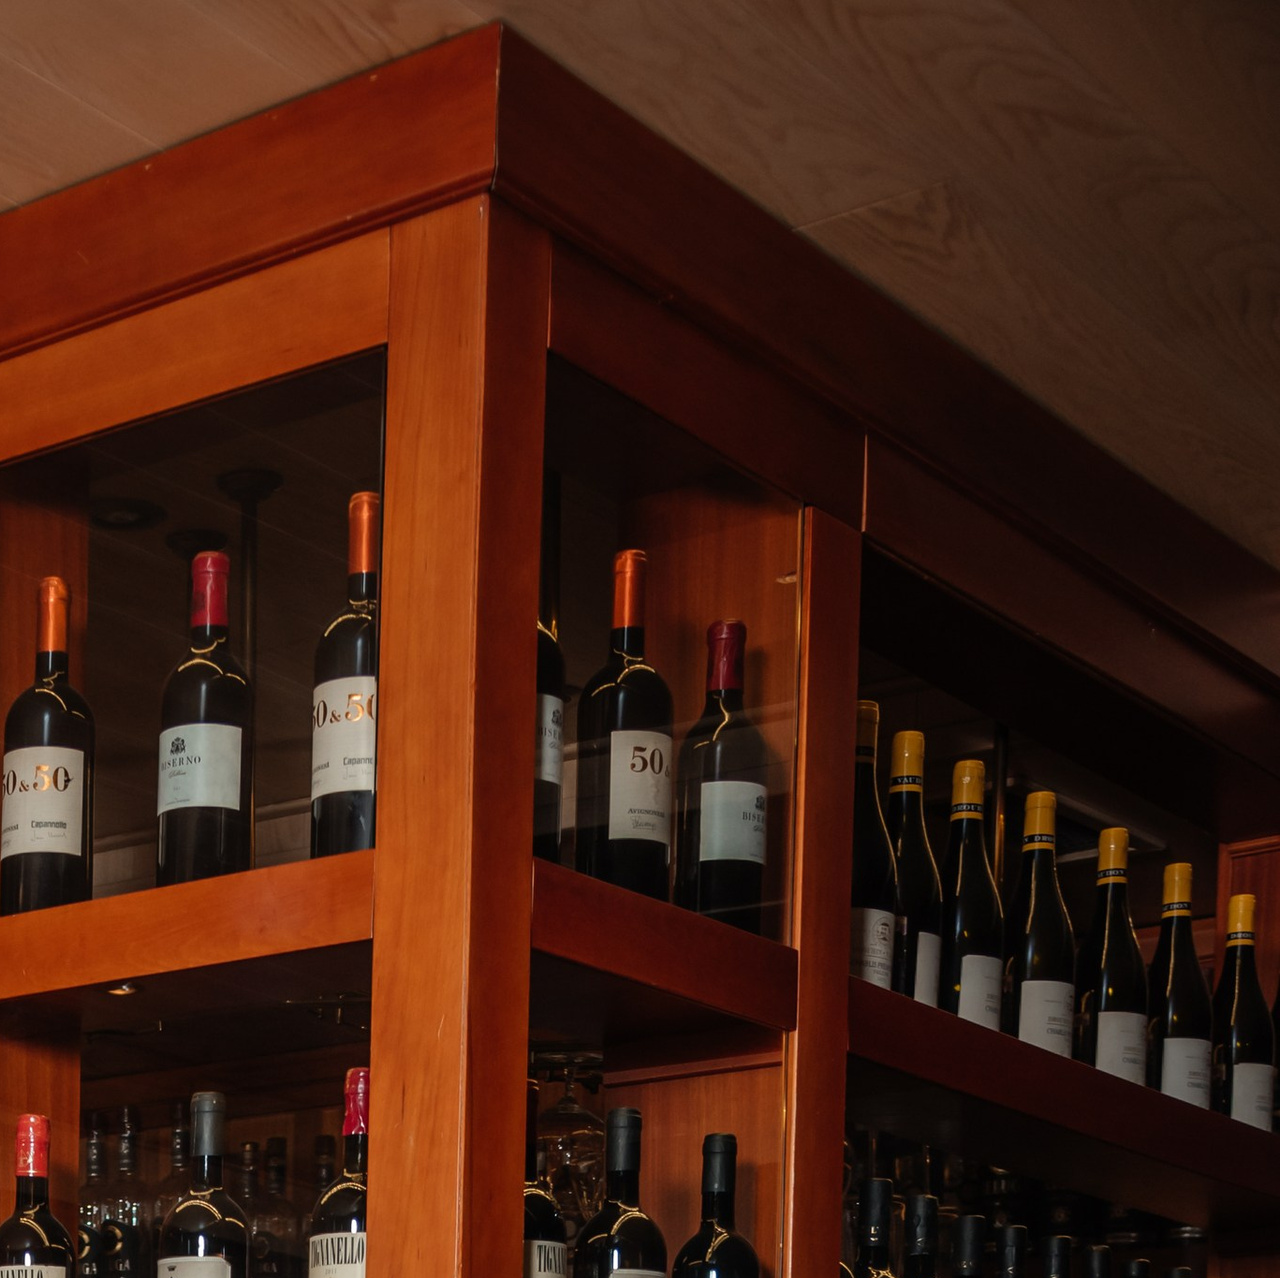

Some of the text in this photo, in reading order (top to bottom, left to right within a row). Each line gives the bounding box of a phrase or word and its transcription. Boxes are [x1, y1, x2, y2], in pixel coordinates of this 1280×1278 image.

[630, 746, 663, 775] 50
[33, 764, 71, 792] 50
[310, 1236, 366, 1270] TIGNANELLO
